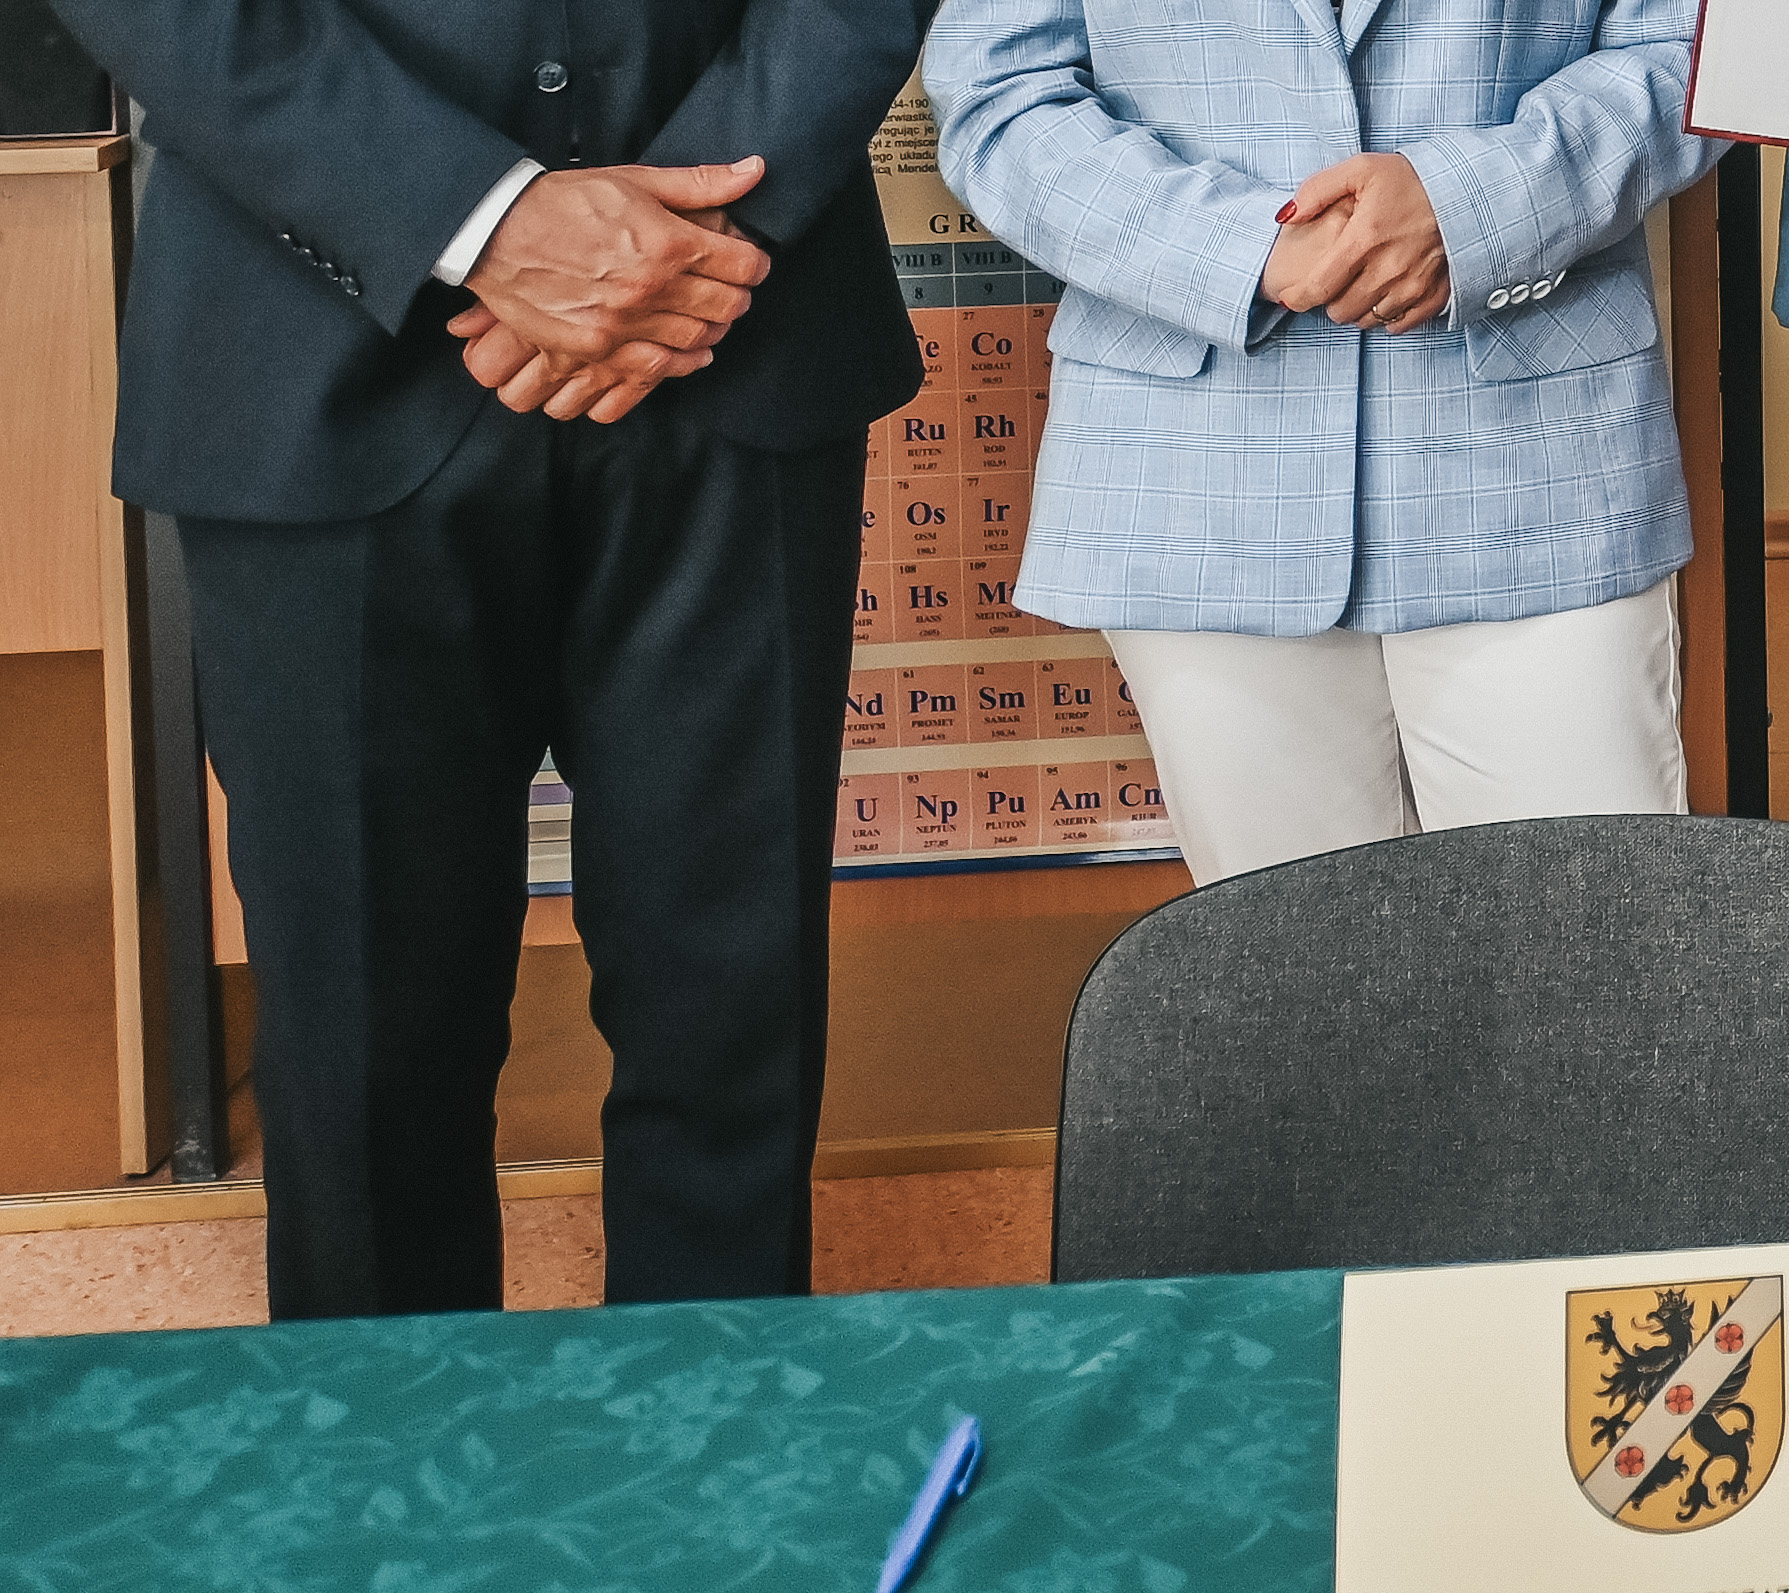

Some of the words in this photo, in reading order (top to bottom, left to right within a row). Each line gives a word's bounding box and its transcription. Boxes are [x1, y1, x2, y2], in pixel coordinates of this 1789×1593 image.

[879, 125, 920, 137] regując
[899, 151, 936, 161] układu
[930, 253, 943, 266] B
[962, 251, 995, 265] VIII
[1001, 251, 1012, 264] B
[914, 287, 924, 300] 8
[983, 283, 993, 294] 9
[962, 312, 975, 320] 27
[971, 332, 1013, 356] Co
[971, 362, 1012, 372] KOBALT
[903, 418, 946, 442] Ru
[973, 414, 1015, 439] Rh
[983, 445, 1006, 454] ROD
[967, 478, 979, 487] 77
[906, 502, 946, 526] Os
[982, 499, 1010, 522] Ir
[862, 510, 876, 528] e
[857, 589, 878, 611] h
[910, 585, 949, 609] Hs
[972, 666, 985, 675] 62
[979, 687, 1025, 710] Sm
[1052, 682, 1092, 706] Eu
[908, 690, 957, 713] Pm
[1054, 712, 1090, 720] EUROP
[911, 719, 954, 728] PROMET
[986, 791, 1026, 814] Pu
[1049, 787, 1101, 811] Am
[855, 798, 878, 822] U
[914, 795, 958, 824] Np
[985, 820, 1027, 830] PLUTON
[1053, 816, 1098, 826] AMERYK
[852, 829, 881, 838] URAN
[916, 825, 957, 834] NEPTUN
